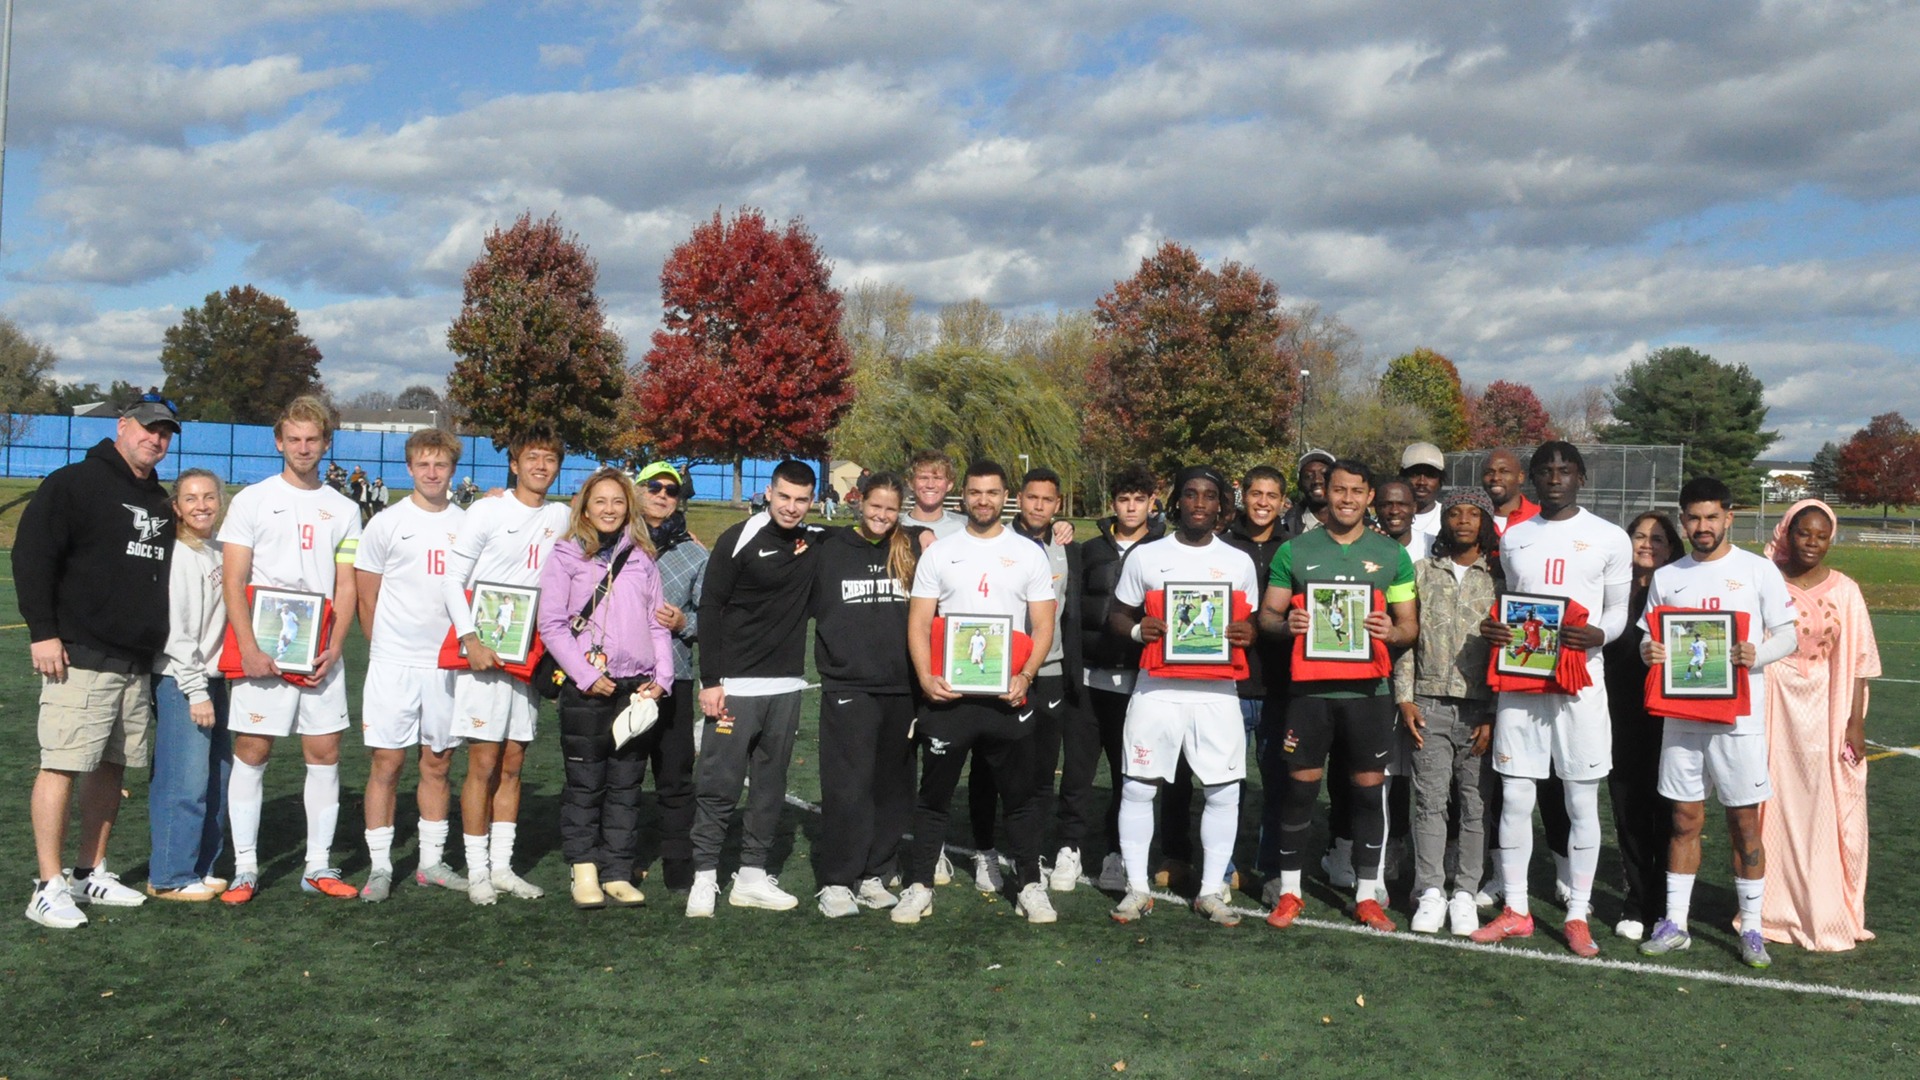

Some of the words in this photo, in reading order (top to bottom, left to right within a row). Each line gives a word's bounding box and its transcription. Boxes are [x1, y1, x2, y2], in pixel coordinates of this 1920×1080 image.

[126, 541, 164, 560] SOCCER
[428, 549, 445, 575] 16
[527, 544, 539, 570] 11
[1545, 558, 1565, 585] 10
[978, 573, 989, 598] 4
